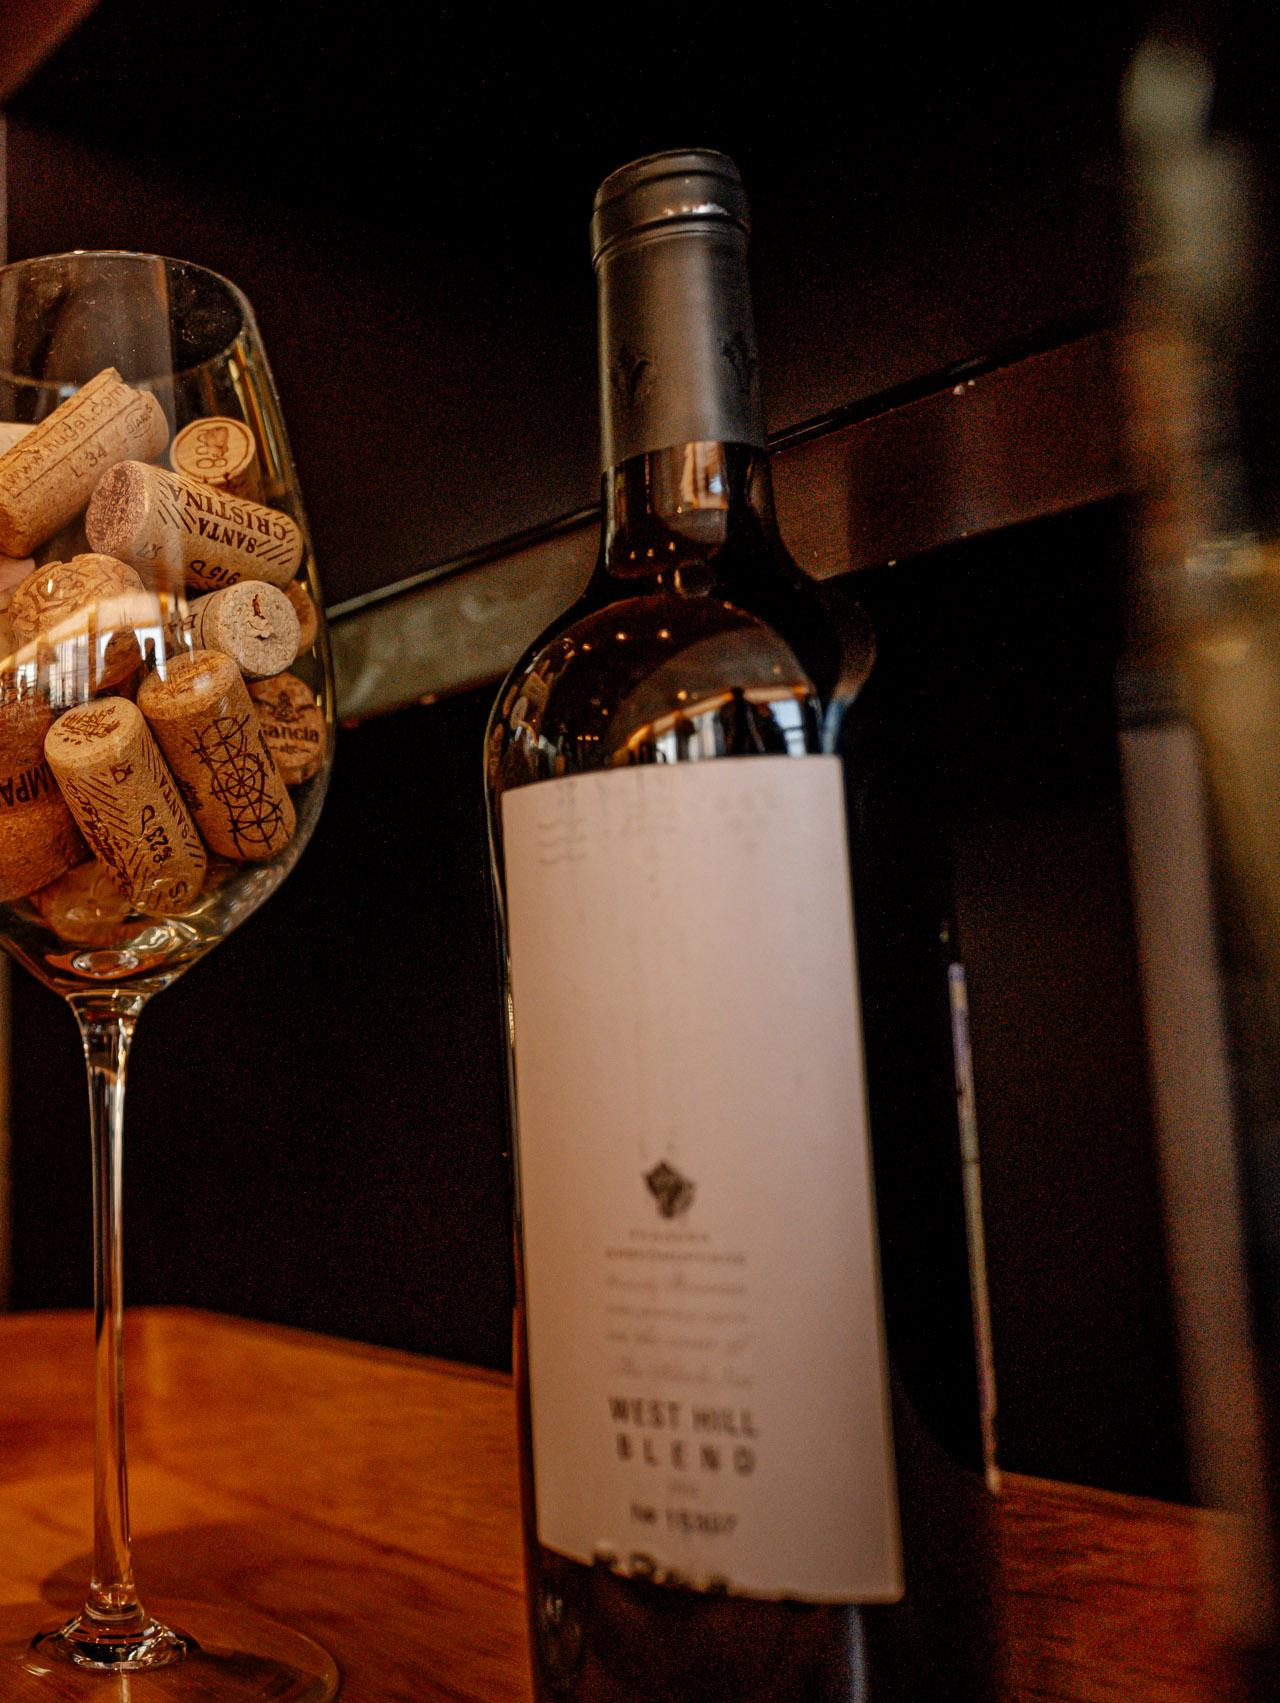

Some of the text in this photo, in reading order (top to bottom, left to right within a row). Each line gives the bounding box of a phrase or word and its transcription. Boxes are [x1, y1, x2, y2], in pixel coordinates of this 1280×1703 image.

[167, 482, 288, 542] CRISTINA
[196, 517, 258, 555] SANTA
[156, 776, 192, 840] SANTA
[608, 1396, 760, 1438] WEST HILL
[616, 1431, 758, 1478] BLEND
